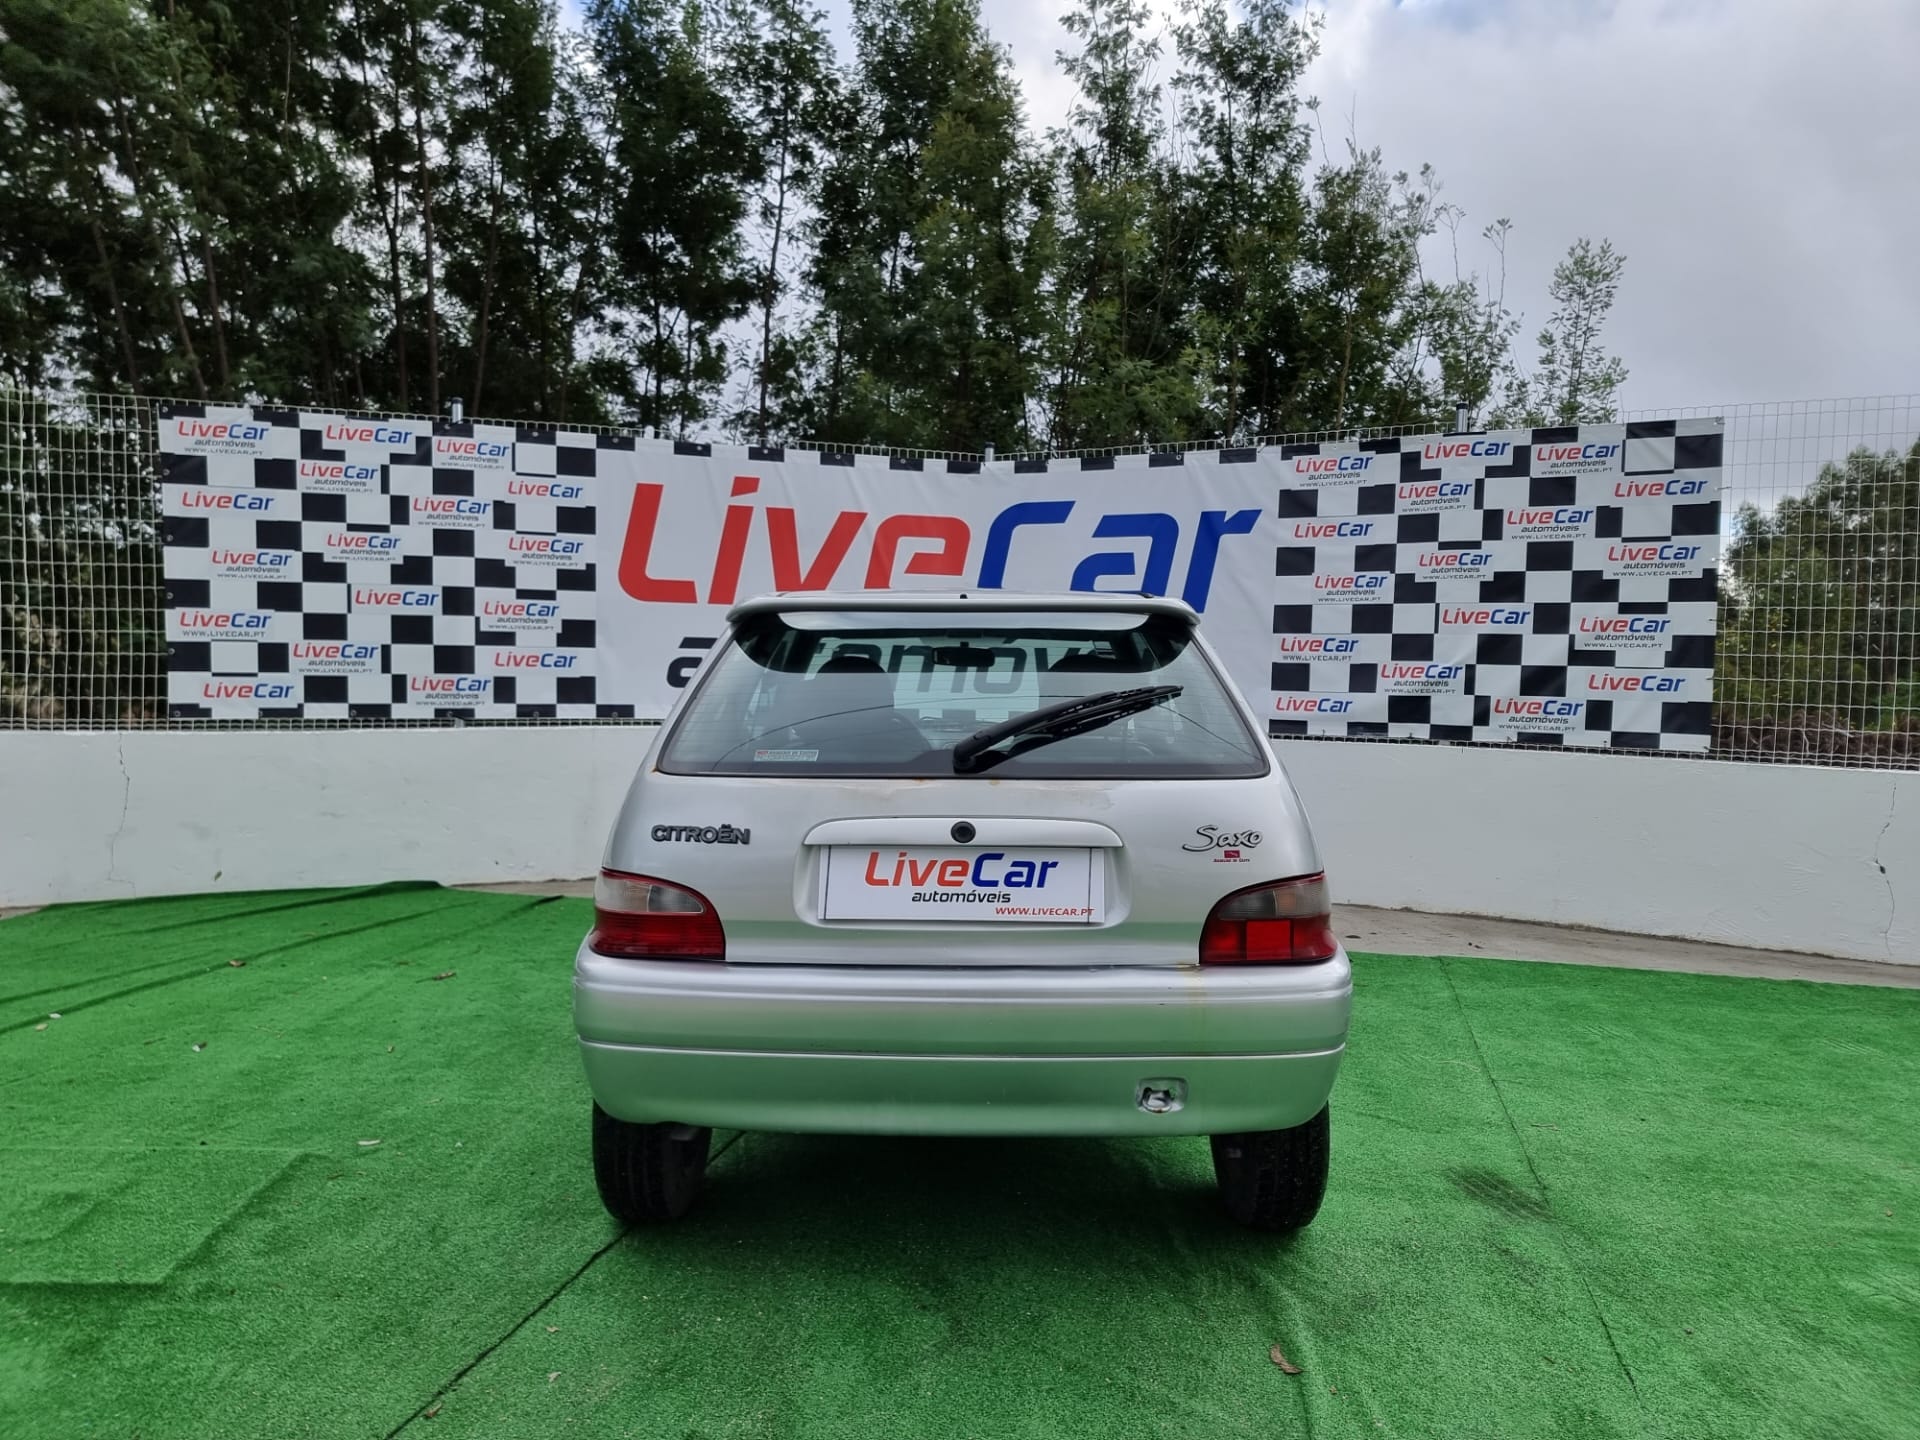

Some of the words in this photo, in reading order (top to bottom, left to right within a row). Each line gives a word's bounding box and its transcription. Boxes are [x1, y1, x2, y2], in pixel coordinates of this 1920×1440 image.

[178, 420, 269, 440] LiveCar
[326, 424, 412, 444] LiveCar
[437, 439, 510, 457] LiveCar
[1424, 441, 1510, 460] LiveCar
[1536, 444, 1620, 461] LiveCar
[300, 462, 378, 480] LiveCar
[1296, 456, 1373, 473] LiveCar
[1550, 459, 1606, 468] automóveis
[1308, 472, 1360, 480] automóveis
[508, 481, 583, 498] LiveCar
[1398, 483, 1472, 499] LiveCar
[1615, 480, 1708, 497] LiveCar
[182, 491, 274, 511] LiveCar
[413, 497, 490, 514] LiveCar
[1411, 497, 1460, 506] automóveis
[1507, 508, 1594, 525] LiveCar
[1295, 522, 1373, 538] LiveCar
[326, 533, 400, 549] LiveCar
[508, 536, 584, 553] LiveCar
[618, 477, 1262, 612] LiveCar
[212, 550, 292, 566] LiveCar
[1419, 553, 1492, 566] LiveCar
[1608, 545, 1701, 561] LiveCar
[1314, 574, 1387, 589] LiveCar
[354, 589, 439, 606] LiveCar
[484, 601, 559, 617] LiveCar
[1442, 608, 1530, 625] LiveCar
[180, 611, 272, 628] LiveCar
[1580, 617, 1671, 633] LiveCar
[293, 643, 378, 658] LiveCar
[1281, 637, 1358, 652] LiveCar
[494, 652, 577, 668] LiveCar
[1381, 664, 1463, 679] LiveCar
[203, 682, 294, 698] LiveCar
[411, 676, 491, 692] LiveCar
[1588, 673, 1685, 692] LiveCar
[1276, 697, 1352, 713] LiveCar
[1494, 698, 1583, 716] LiveCar
[1508, 716, 1568, 724] automóveis
[651, 824, 751, 845] CITROËN
[1182, 825, 1263, 852] Saxo
[865, 851, 1059, 889] LiveCar
[911, 889, 1011, 903] automóveis
[995, 907, 1094, 916] WWW.LIVECAR.PT
